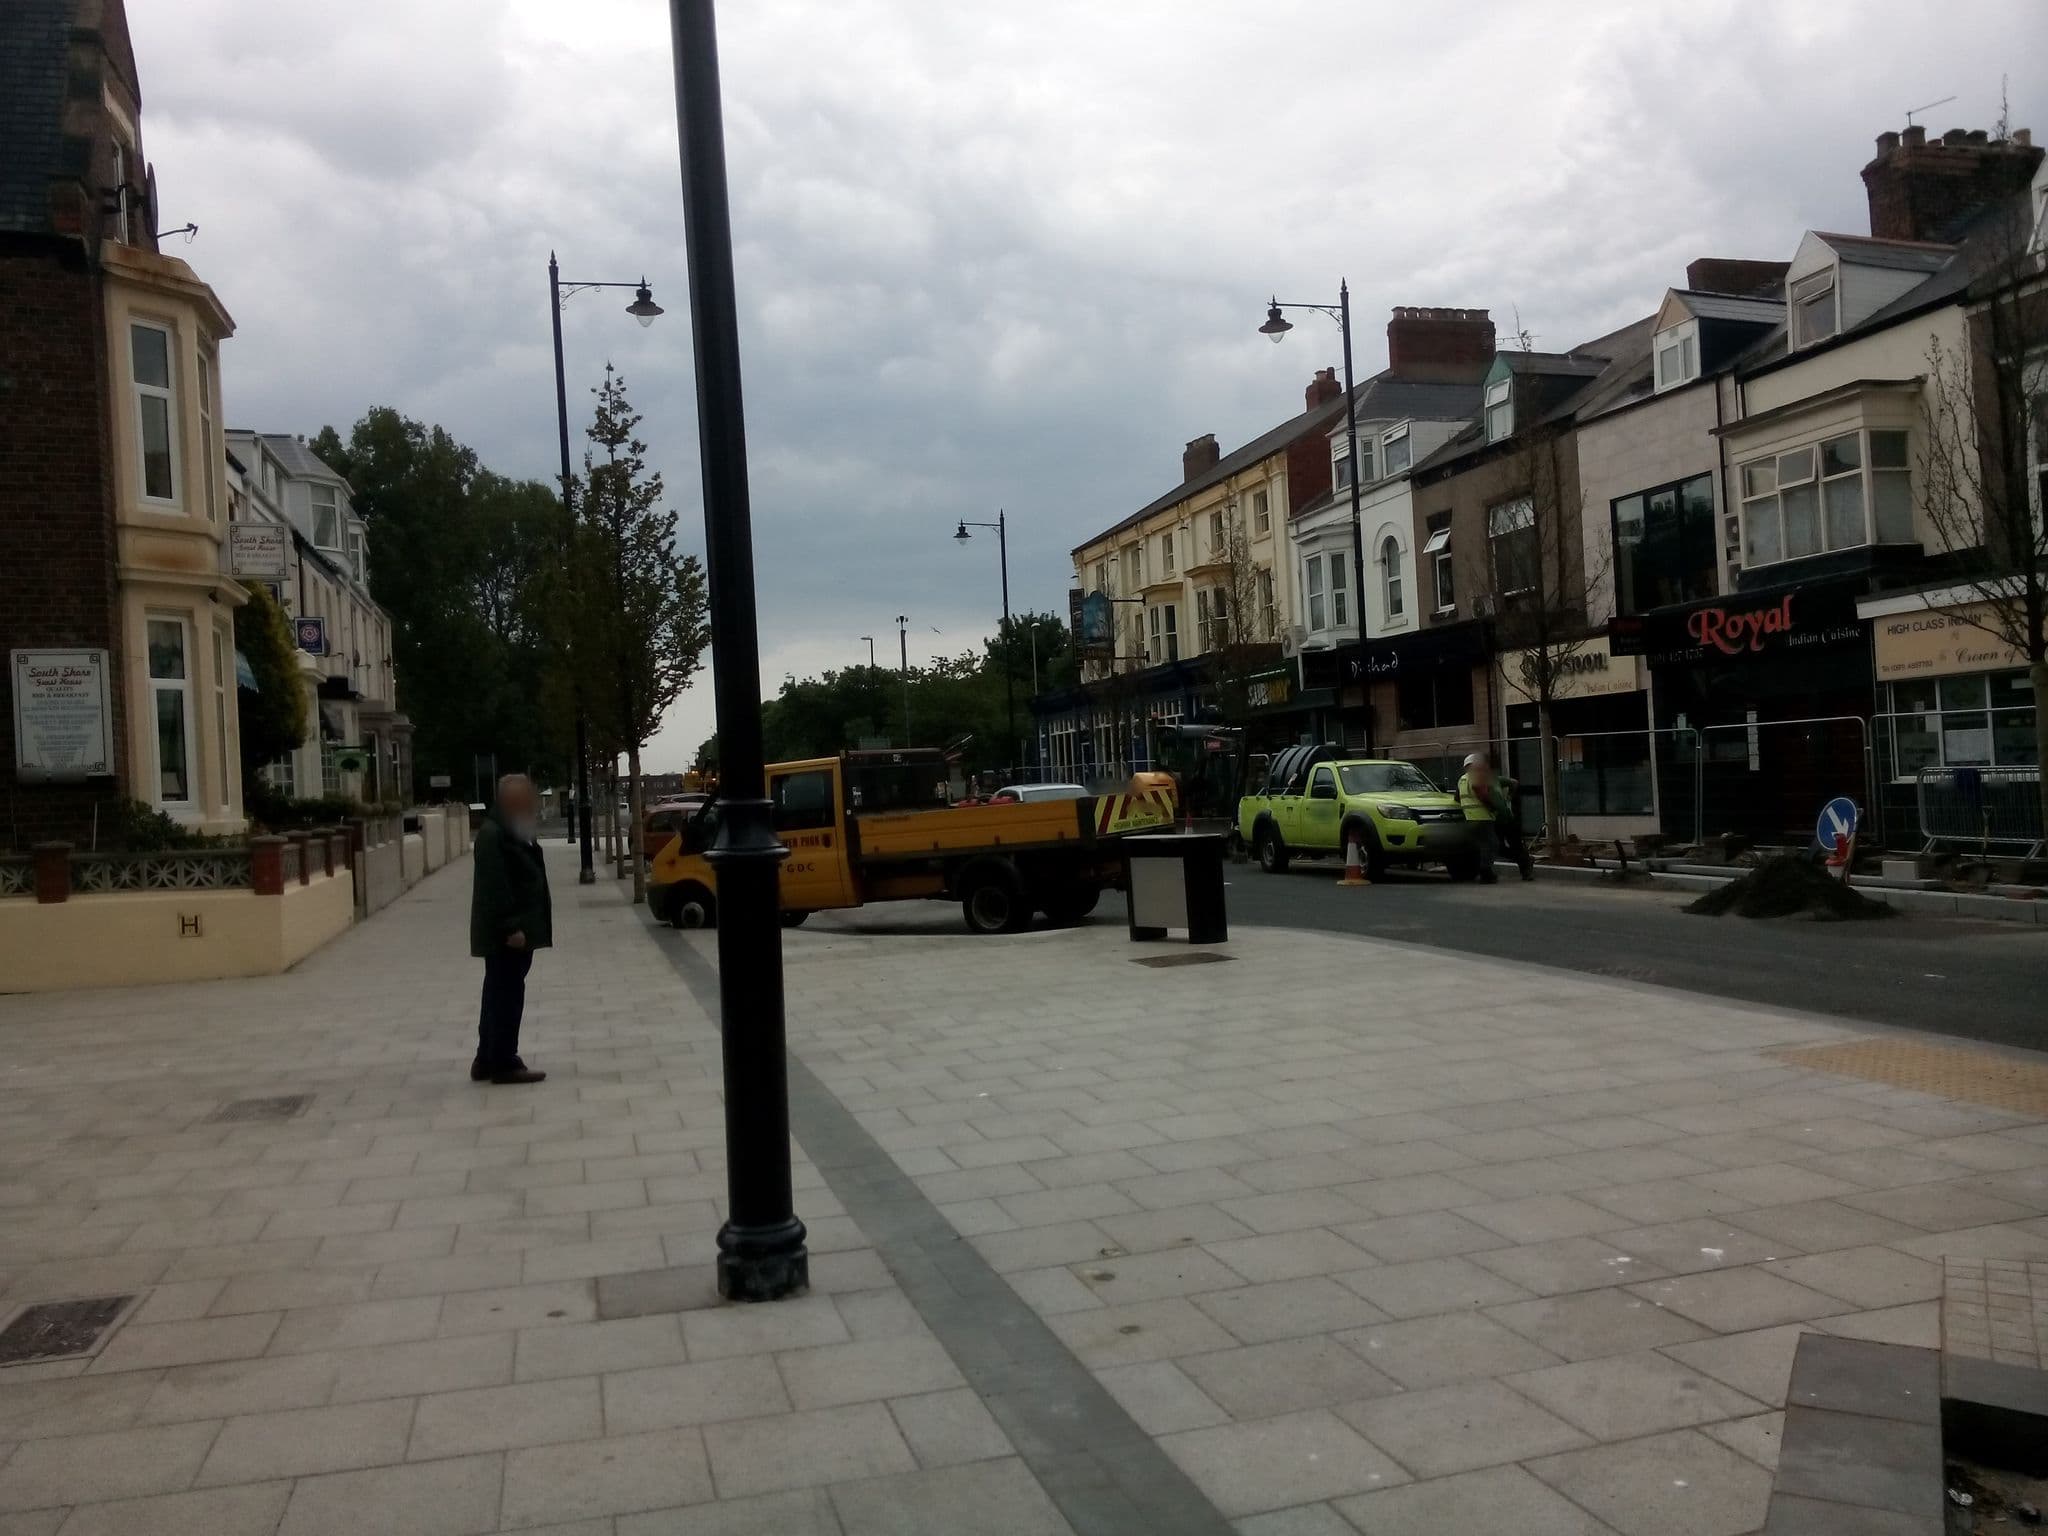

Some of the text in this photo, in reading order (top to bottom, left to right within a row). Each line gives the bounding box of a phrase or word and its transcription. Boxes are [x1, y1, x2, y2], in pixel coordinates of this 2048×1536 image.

[233, 536, 257, 545] South
[1687, 593, 1795, 655] Royal
[1887, 613, 1982, 636] HIGH CLASS INDIAN
[1788, 626, 1862, 647] Indian Cuisine
[1955, 647, 1998, 664] Crown
[29, 667, 91, 678] South Shore
